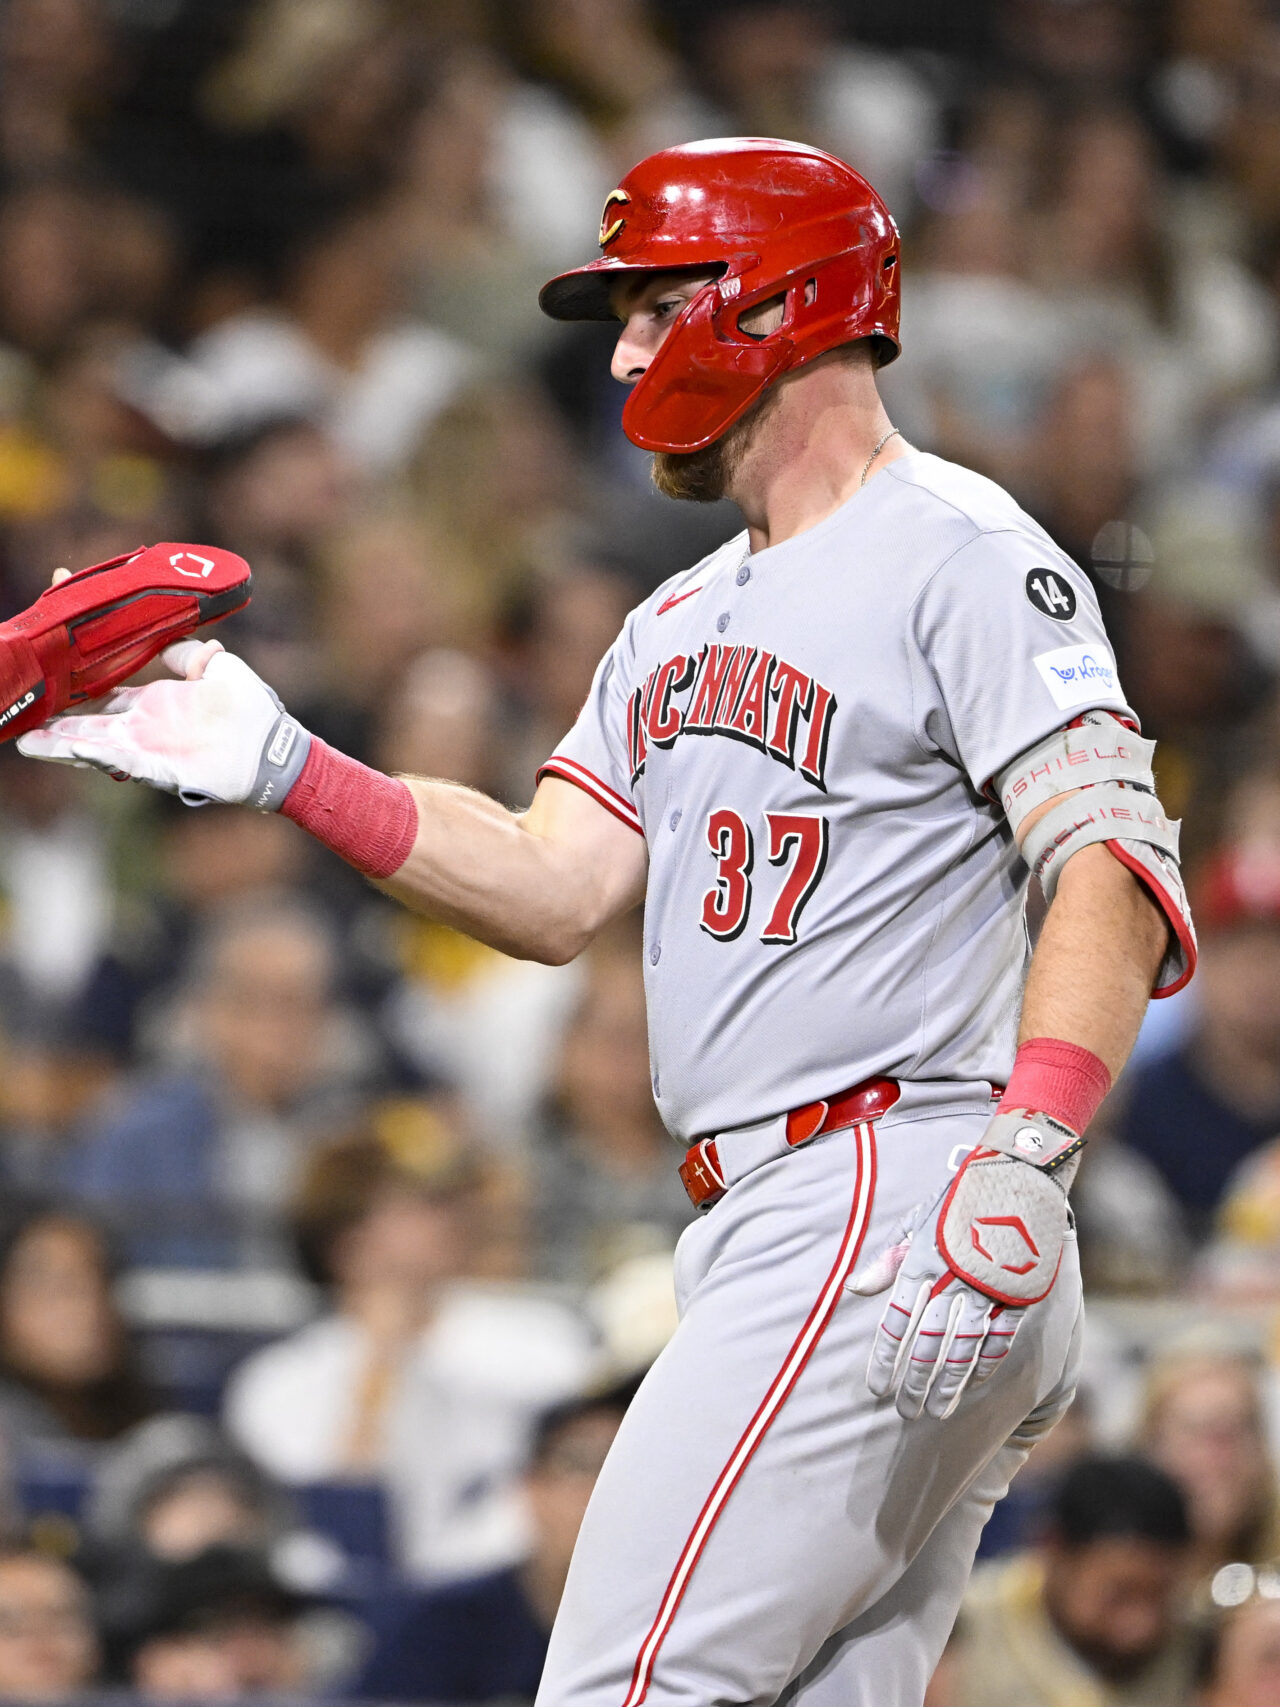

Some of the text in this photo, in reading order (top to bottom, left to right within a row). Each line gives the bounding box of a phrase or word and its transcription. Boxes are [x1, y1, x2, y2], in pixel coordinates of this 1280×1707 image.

[1031, 575, 1070, 613] 14
[1003, 746, 1132, 813] OSHIELD
[700, 806, 830, 945] 37
